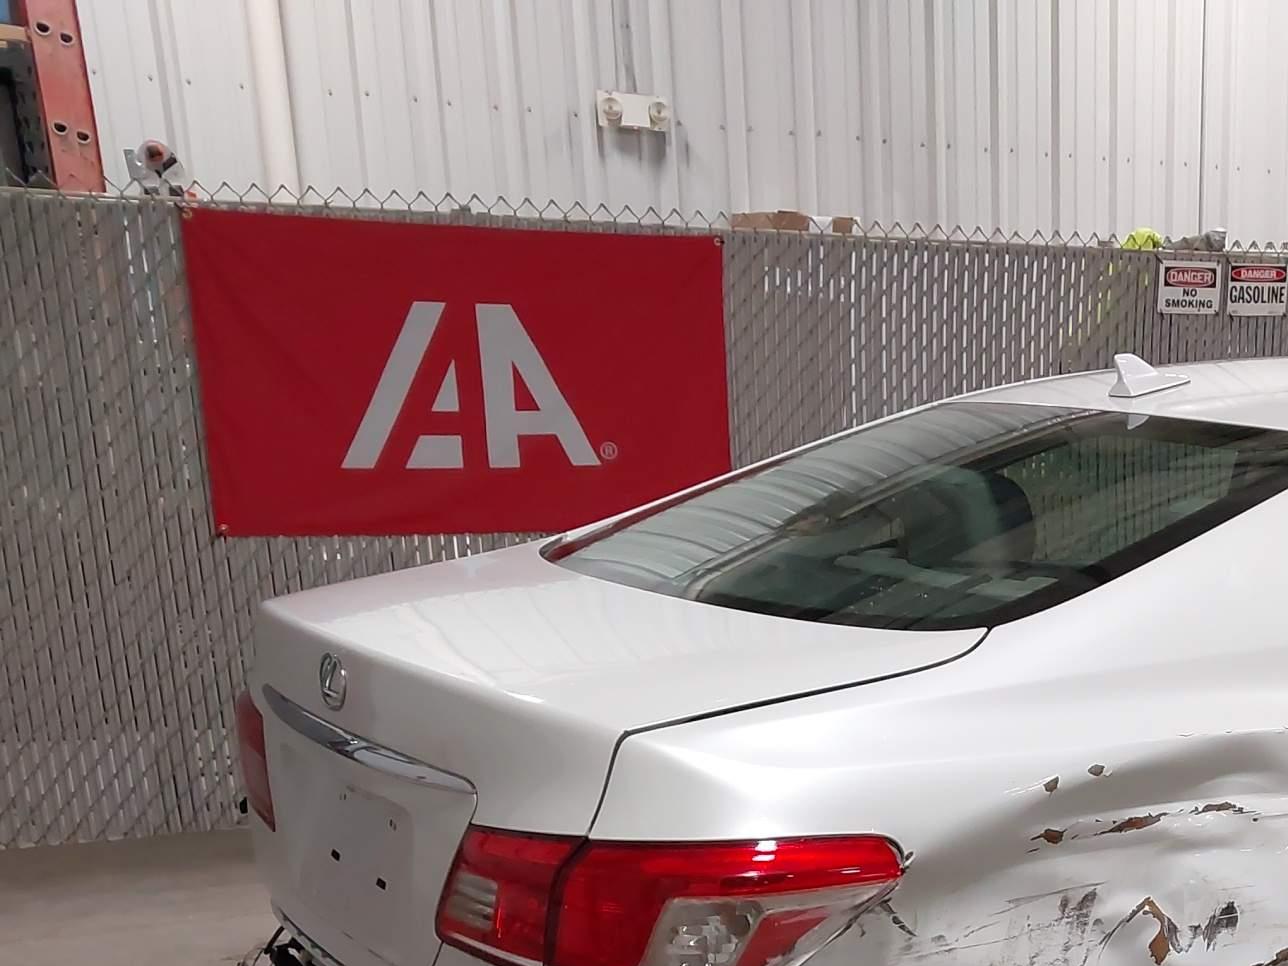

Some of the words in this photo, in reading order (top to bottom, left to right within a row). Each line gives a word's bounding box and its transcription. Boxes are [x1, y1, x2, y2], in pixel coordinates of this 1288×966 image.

[1170, 270, 1212, 283] DANGER
[1240, 269, 1277, 279] DANGER
[1182, 288, 1198, 298] NO
[1229, 285, 1286, 304] GASOLINE
[1164, 298, 1214, 309] SMOKING
